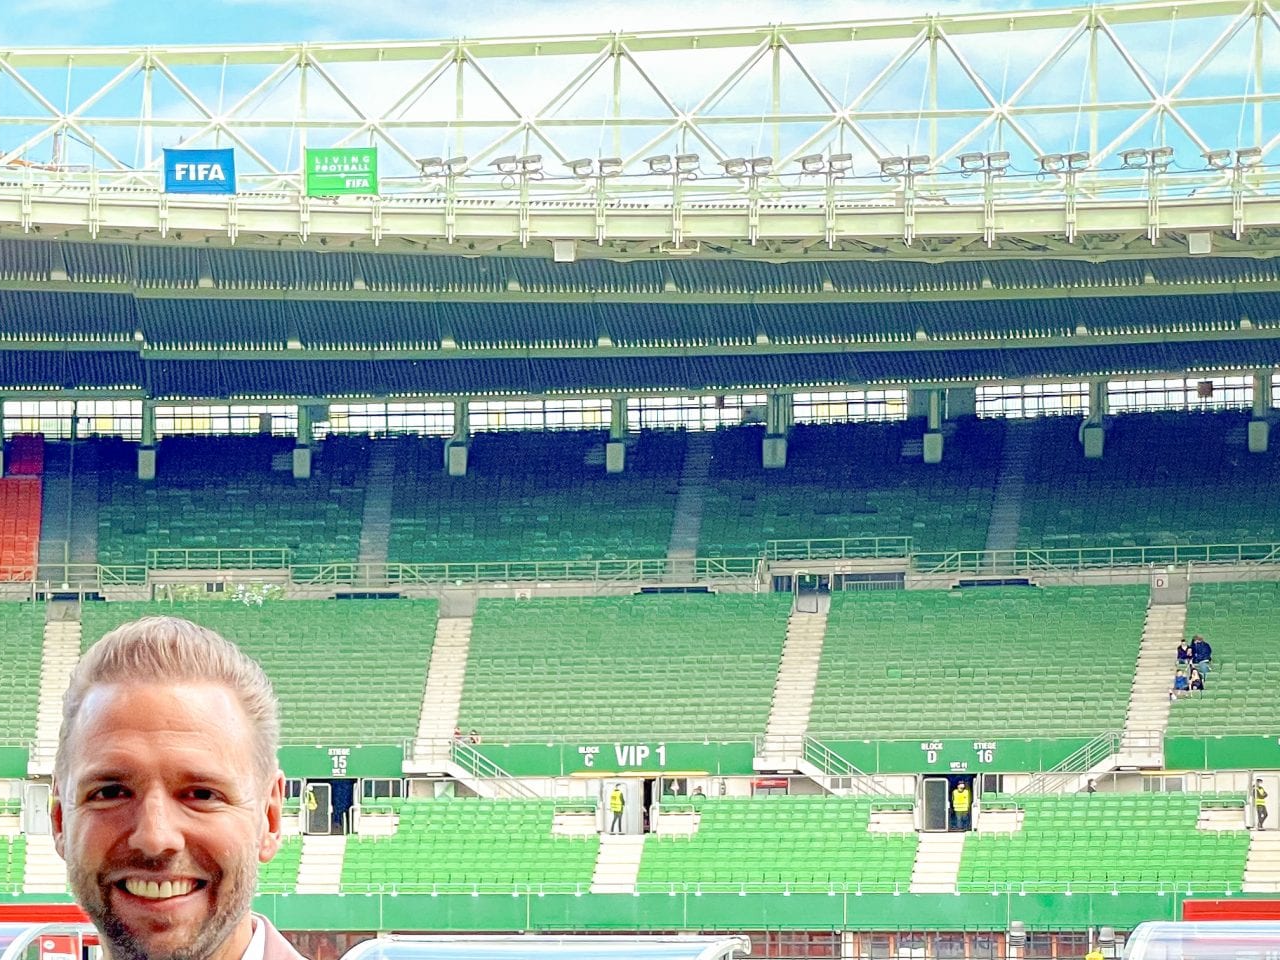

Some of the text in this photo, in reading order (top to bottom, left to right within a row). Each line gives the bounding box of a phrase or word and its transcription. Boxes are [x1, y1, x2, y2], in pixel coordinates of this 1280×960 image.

[315, 155, 370, 164] LIVING
[175, 163, 225, 181] FIFA
[314, 164, 370, 172] FOOTBALL
[345, 178, 370, 188] FIFA
[578, 746, 600, 754] BLOCK
[921, 742, 943, 750] BLOCK
[973, 742, 997, 750] STIEGE
[584, 753, 594, 767] C
[615, 745, 666, 767] VIP 1
[927, 750, 937, 764] D
[976, 750, 993, 763] 16
[332, 755, 347, 769] 15
